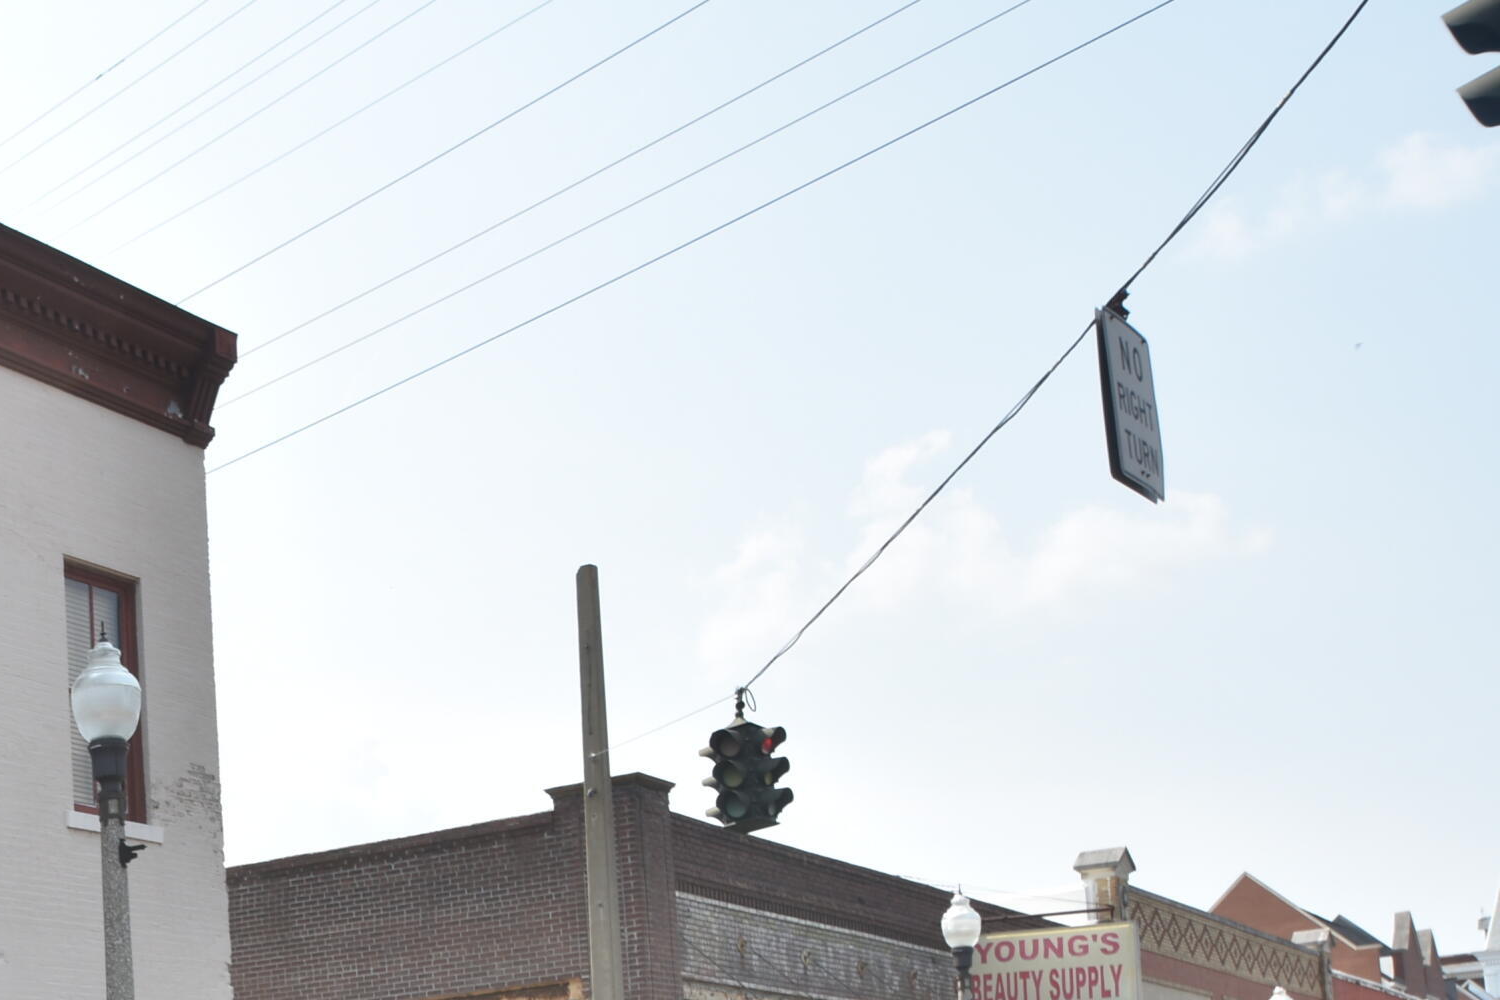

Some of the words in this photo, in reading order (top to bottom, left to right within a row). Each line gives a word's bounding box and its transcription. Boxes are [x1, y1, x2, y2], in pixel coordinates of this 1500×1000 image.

[1119, 336, 1143, 383] NO
[1117, 382, 1153, 432] RIGHT
[1125, 429, 1159, 477] TURN
[974, 932, 1120, 964] YOUNG'S
[1050, 964, 1122, 1000] SUPPLY
